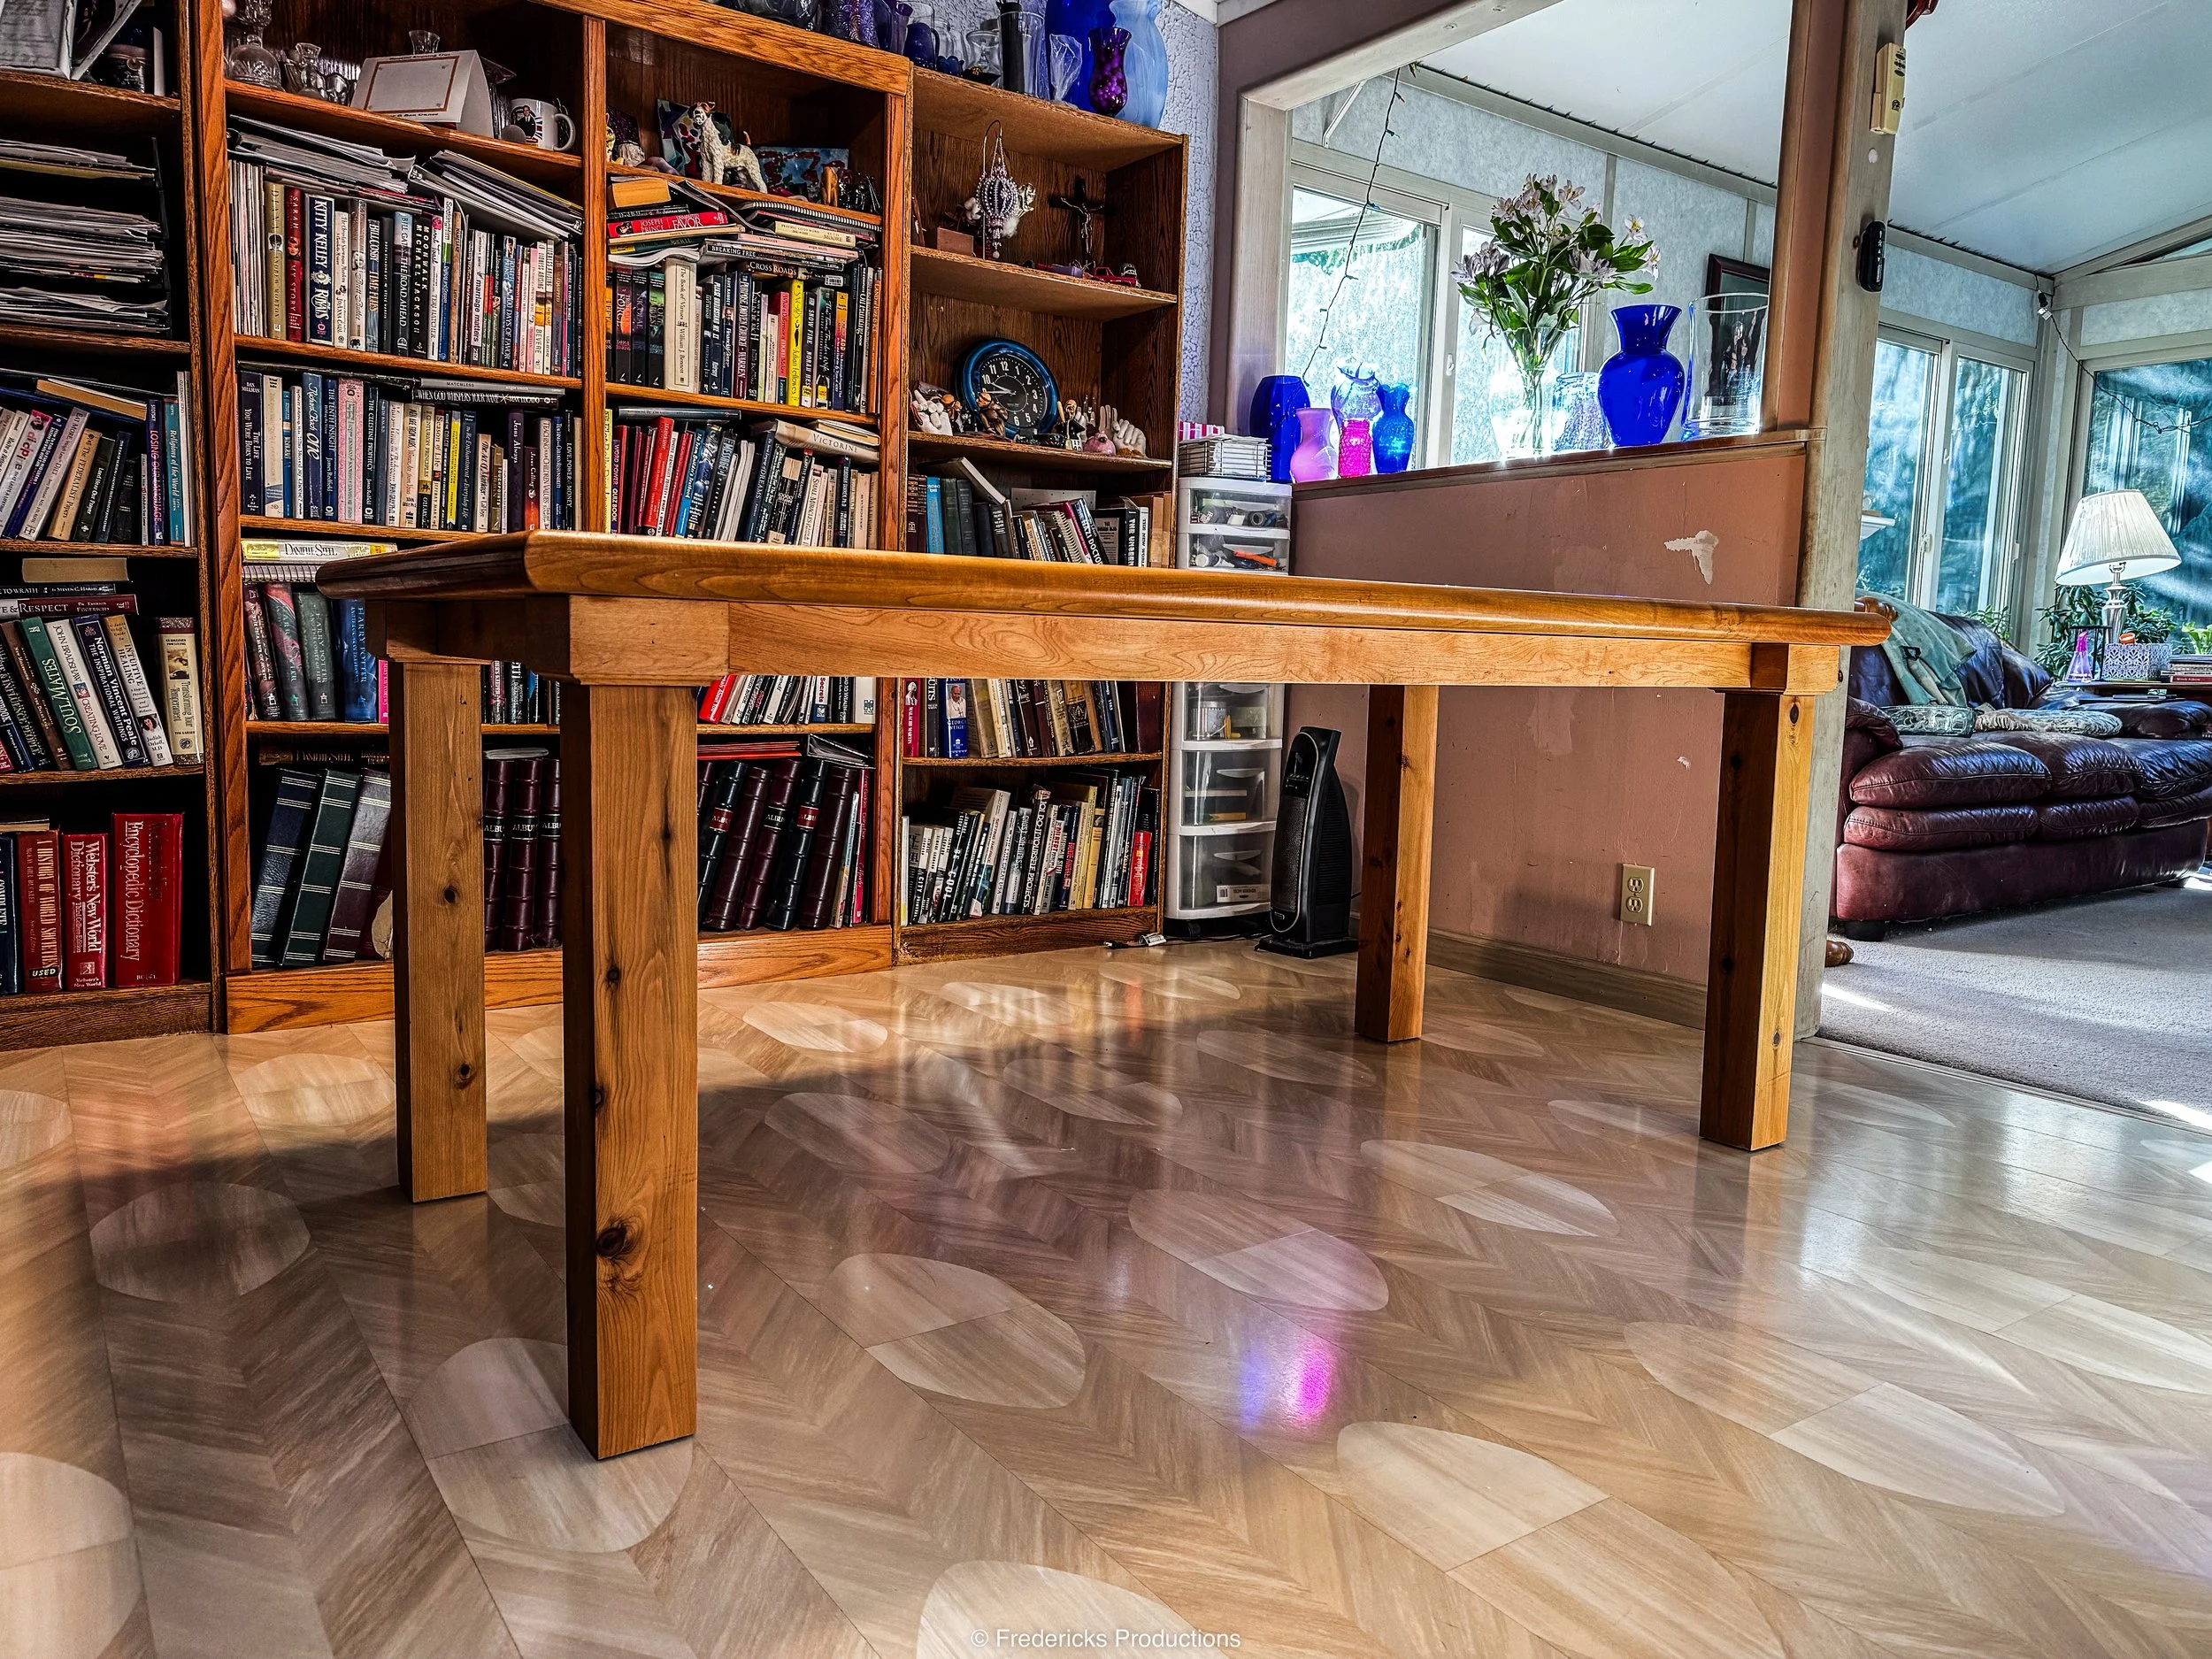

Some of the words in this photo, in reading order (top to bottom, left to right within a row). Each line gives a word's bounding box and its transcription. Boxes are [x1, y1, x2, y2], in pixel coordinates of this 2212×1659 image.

[314, 199, 328, 231] KITTY
[640, 218, 664, 227] JOSEPH
[672, 217, 703, 230] FAVOR
[369, 224, 379, 239] BILL
[640, 225, 664, 234] PRINCE
[314, 233, 328, 268] KELLEY
[369, 239, 379, 262] COSBY
[710, 245, 740, 256] BREAKING
[741, 249, 757, 257] FREE
[290, 265, 297, 278] MY
[369, 270, 378, 290] TIME
[749, 261, 772, 273] CROSS
[772, 263, 797, 275] ROADS
[355, 273, 364, 295] Brett
[473, 279, 484, 313] marriage
[740, 280, 749, 305] PURPOSE
[311, 288, 328, 319] ROYALS
[355, 295, 364, 321] Butler
[369, 291, 378, 311] FLIES
[398, 297, 407, 326] AHEAD
[739, 305, 748, 324] DRIVEN
[472, 314, 481, 342] matters
[503, 326, 511, 336] OF
[739, 324, 748, 347] CHURCH
[503, 337, 511, 359] FAVOR
[737, 351, 747, 378] WARREN
[988, 365, 997, 375] 11
[1000, 361, 1010, 372] 12
[1015, 365, 1020, 376] 1
[792, 367, 801, 395] Fellowes
[981, 374, 991, 385] 10
[1025, 374, 1032, 386] 2
[1032, 389, 1039, 400] 3
[1013, 416, 1020, 426] 6
[1025, 412, 1032, 423] 5
[1033, 403, 1038, 414] 4
[434, 416, 443, 442] Season
[511, 440, 520, 464] Always
[812, 433, 858, 453] VICTORINE
[245, 457, 252, 466] TO
[434, 452, 442, 468] Life
[718, 442, 734, 471] MESSAGE
[68, 457, 88, 498] FEDERALIST
[755, 468, 766, 499] DREAMS
[811, 478, 820, 495] SMALL
[60, 495, 73, 518] Papers
[807, 494, 817, 527] MIRACLES
[284, 543, 315, 557] DANIELLE
[314, 543, 338, 557] STEEL
[19, 603, 69, 613] RESPECT
[357, 607, 367, 644] HARRY
[53, 625, 67, 646] JOHN
[60, 644, 82, 683] BRADSHAW
[88, 642, 97, 657] THE
[119, 649, 135, 685] HEALING
[124, 643, 144, 687] INTUITIVE
[319, 649, 327, 683] POTTER
[358, 647, 367, 683] POTTER
[92, 657, 118, 709] INSPIRATIONAL
[94, 637, 113, 679] Norman
[109, 679, 128, 719] Vincent
[123, 718, 138, 746] Peale
[818, 677, 827, 703] Secrets
[183, 680, 192, 713] Transforming
[6, 677, 27, 724] INFLUENCE
[22, 723, 42, 757] PEOPLE
[81, 698, 99, 733] CREATING
[94, 731, 106, 751] LOVE
[111, 708, 128, 742] WRITINGS
[1021, 813, 1030, 833] GHOST
[1015, 833, 1028, 864] SOLDIERS
[1029, 813, 1045, 873] DO-IT-YOURSELF
[36, 847, 54, 880] HISTORY
[68, 841, 85, 902] Dictionary
[86, 841, 100, 891] Webster's
[119, 820, 145, 898] Encyclopedic
[39, 883, 56, 894] OF
[942, 870, 957, 899] COOL
[1022, 872, 1035, 909] PROJECTS
[39, 896, 57, 926] WORLD
[87, 892, 101, 916] New
[87, 916, 102, 954] World
[119, 900, 145, 962] Dictionary
[41, 927, 60, 969] SOCIETIES
[32, 969, 56, 978] USED
